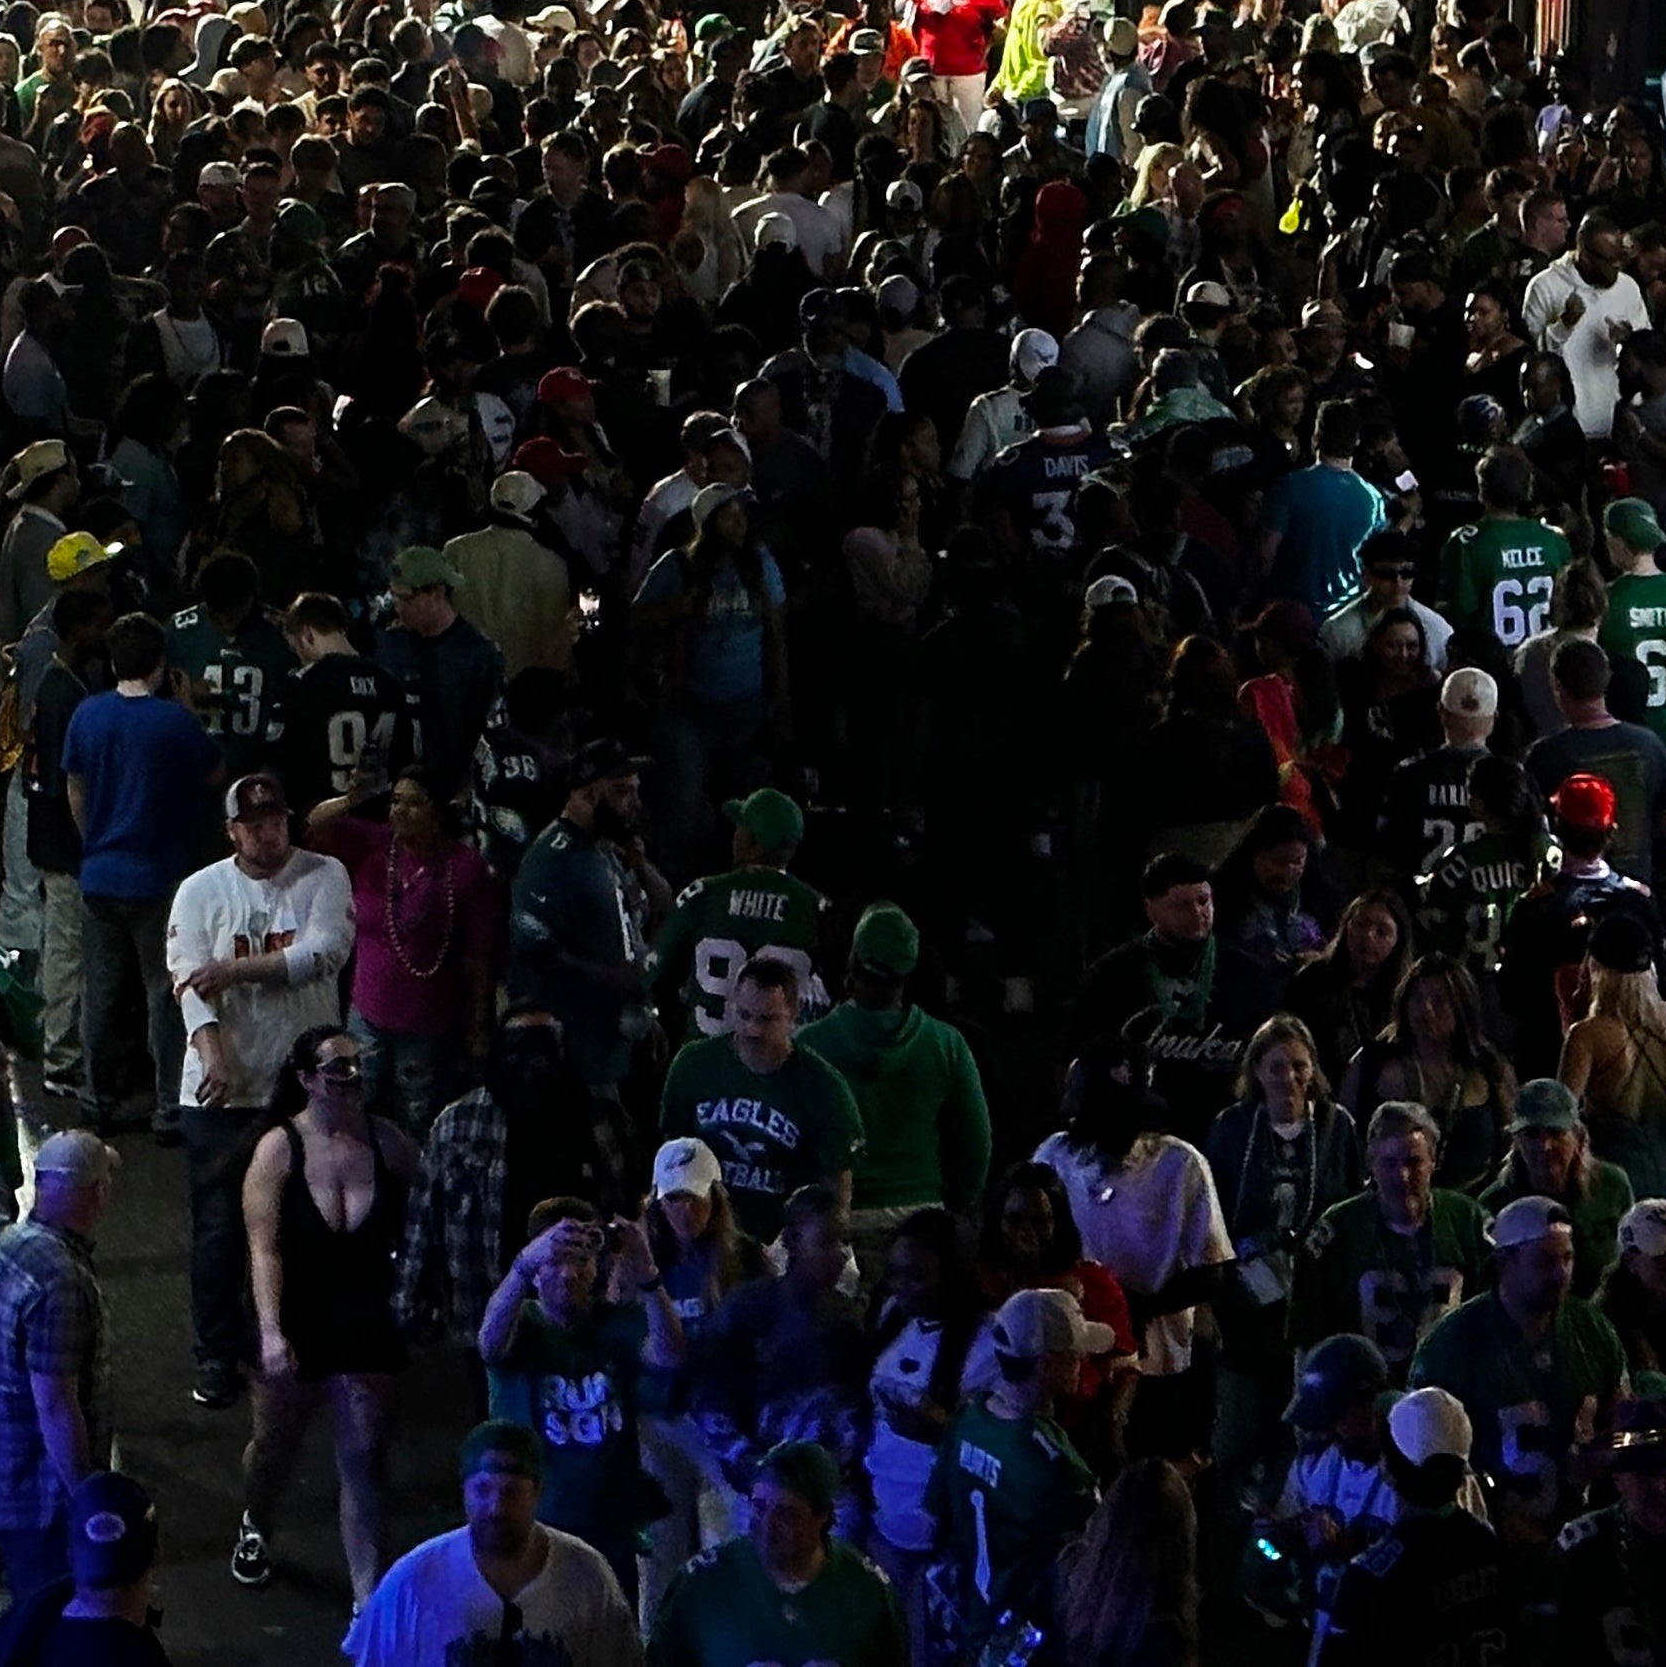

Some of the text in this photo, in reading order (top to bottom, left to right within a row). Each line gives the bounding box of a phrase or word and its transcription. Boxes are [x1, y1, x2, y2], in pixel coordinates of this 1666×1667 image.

[1043, 453, 1091, 478] DAVIS
[1029, 489, 1075, 552] 3
[1491, 575, 1555, 647] 62
[727, 888, 790, 922] WHITE
[695, 1095, 803, 1152] EAGLES
